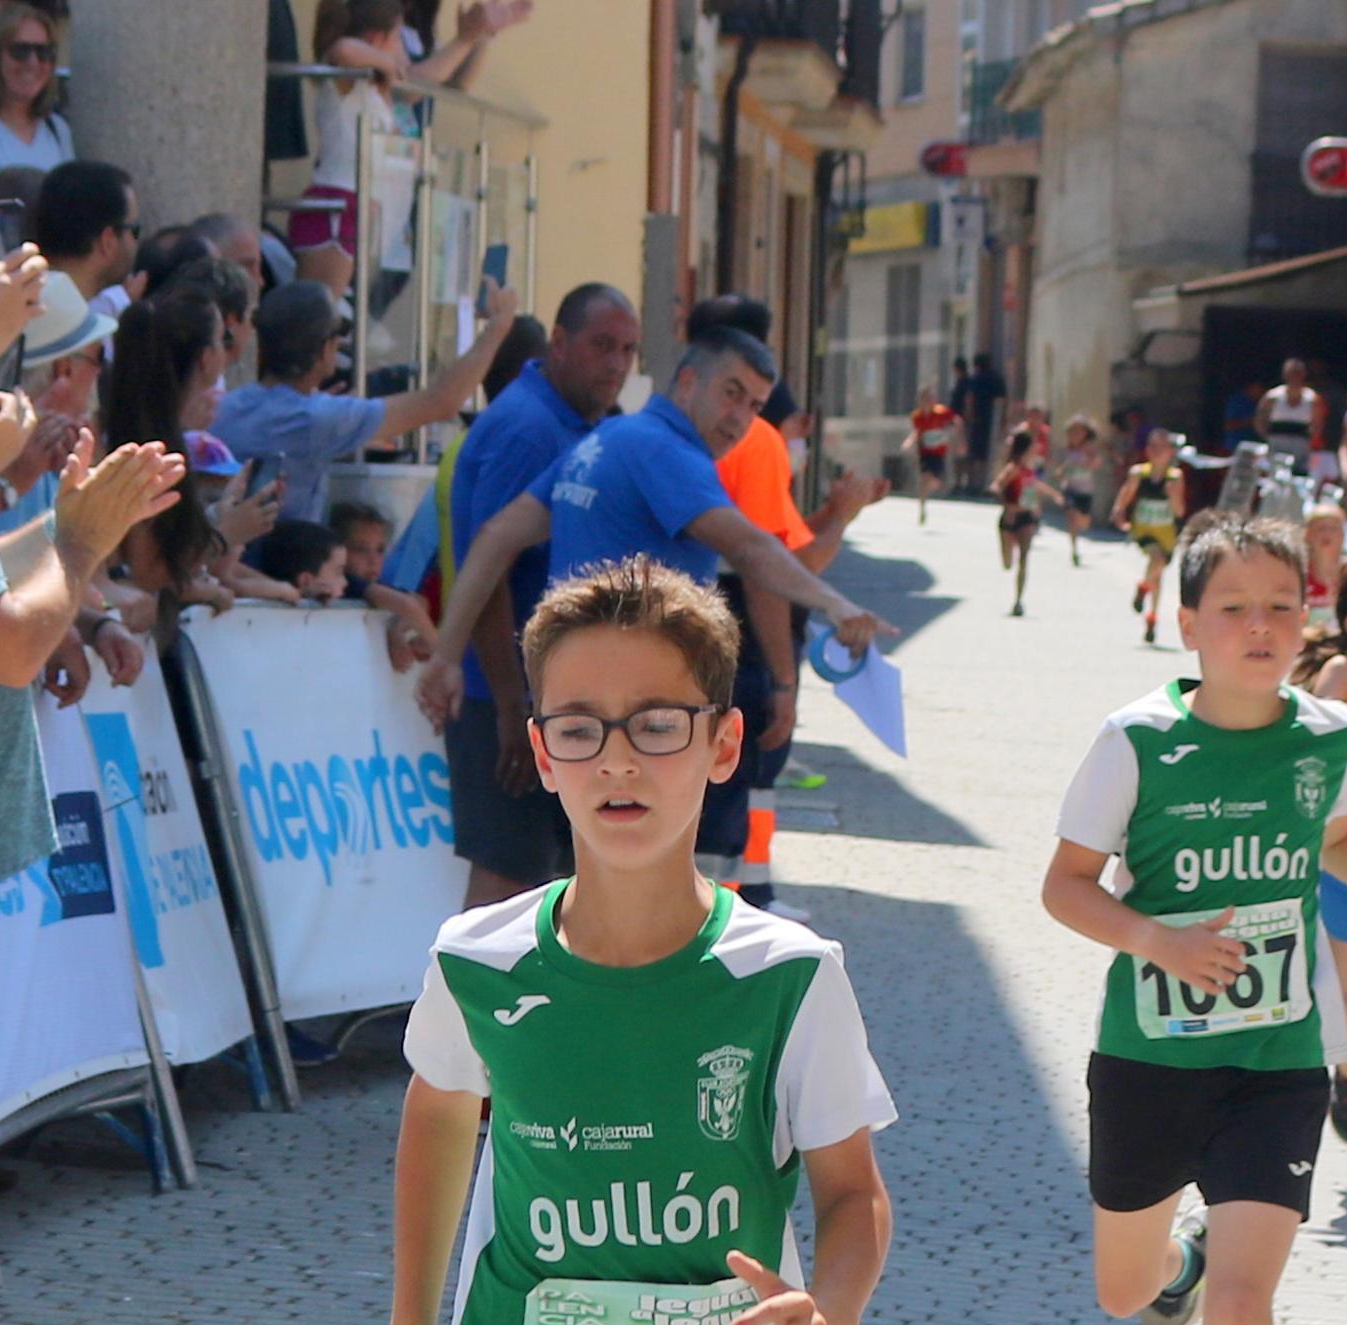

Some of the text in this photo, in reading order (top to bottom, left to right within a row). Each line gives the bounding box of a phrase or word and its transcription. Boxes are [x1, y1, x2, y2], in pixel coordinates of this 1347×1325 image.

[238, 729, 454, 887] deportes
[1174, 832, 1310, 892] gullón
[582, 1122, 654, 1142] cajarural
[529, 1171, 740, 1264] gullón
